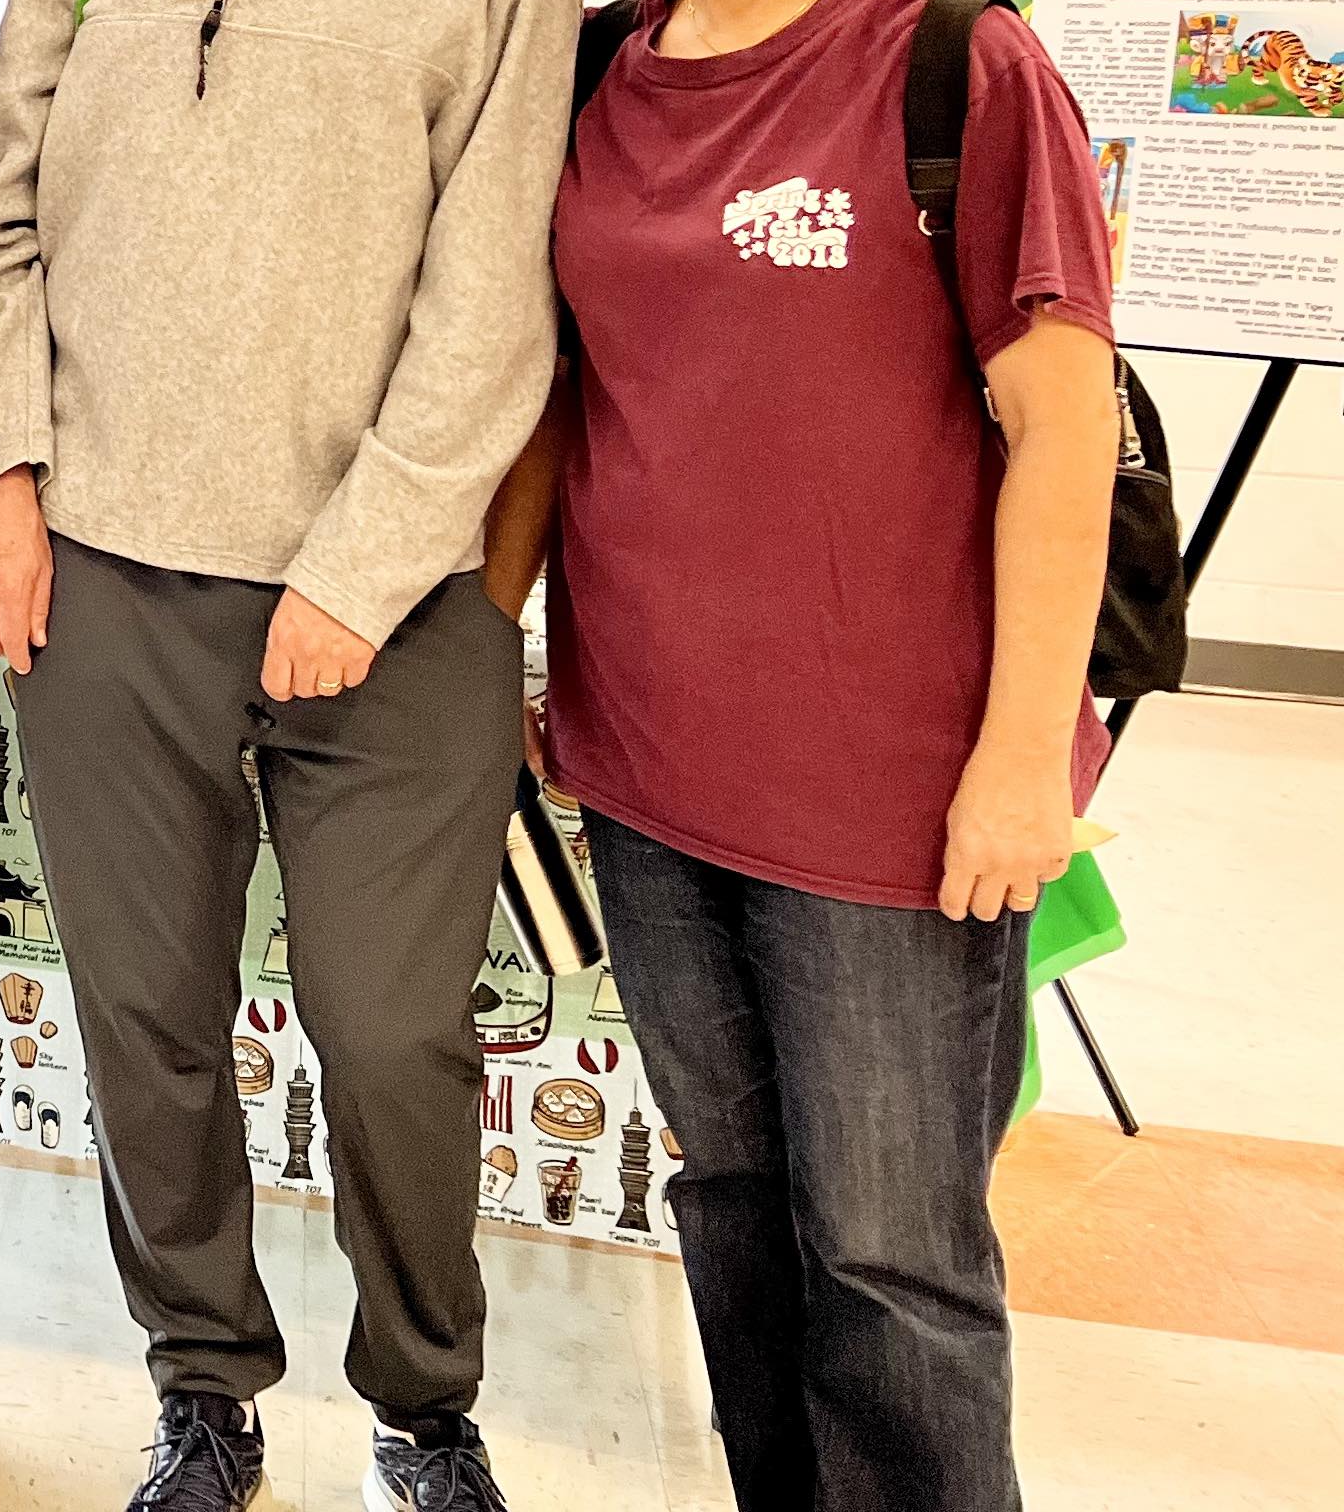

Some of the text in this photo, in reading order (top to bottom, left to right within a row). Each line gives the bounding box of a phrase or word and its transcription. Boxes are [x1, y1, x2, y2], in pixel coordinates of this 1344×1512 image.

[733, 189, 822, 214] Spring
[751, 215, 813, 239] Fest
[773, 243, 848, 269] 2018
[1, 828, 17, 837] 101
[22, 943, 61, 956] Kai-shek
[42, 956, 60, 965] Hall
[257, 974, 293, 985] Nation
[478, 1205, 497, 1217] eep
